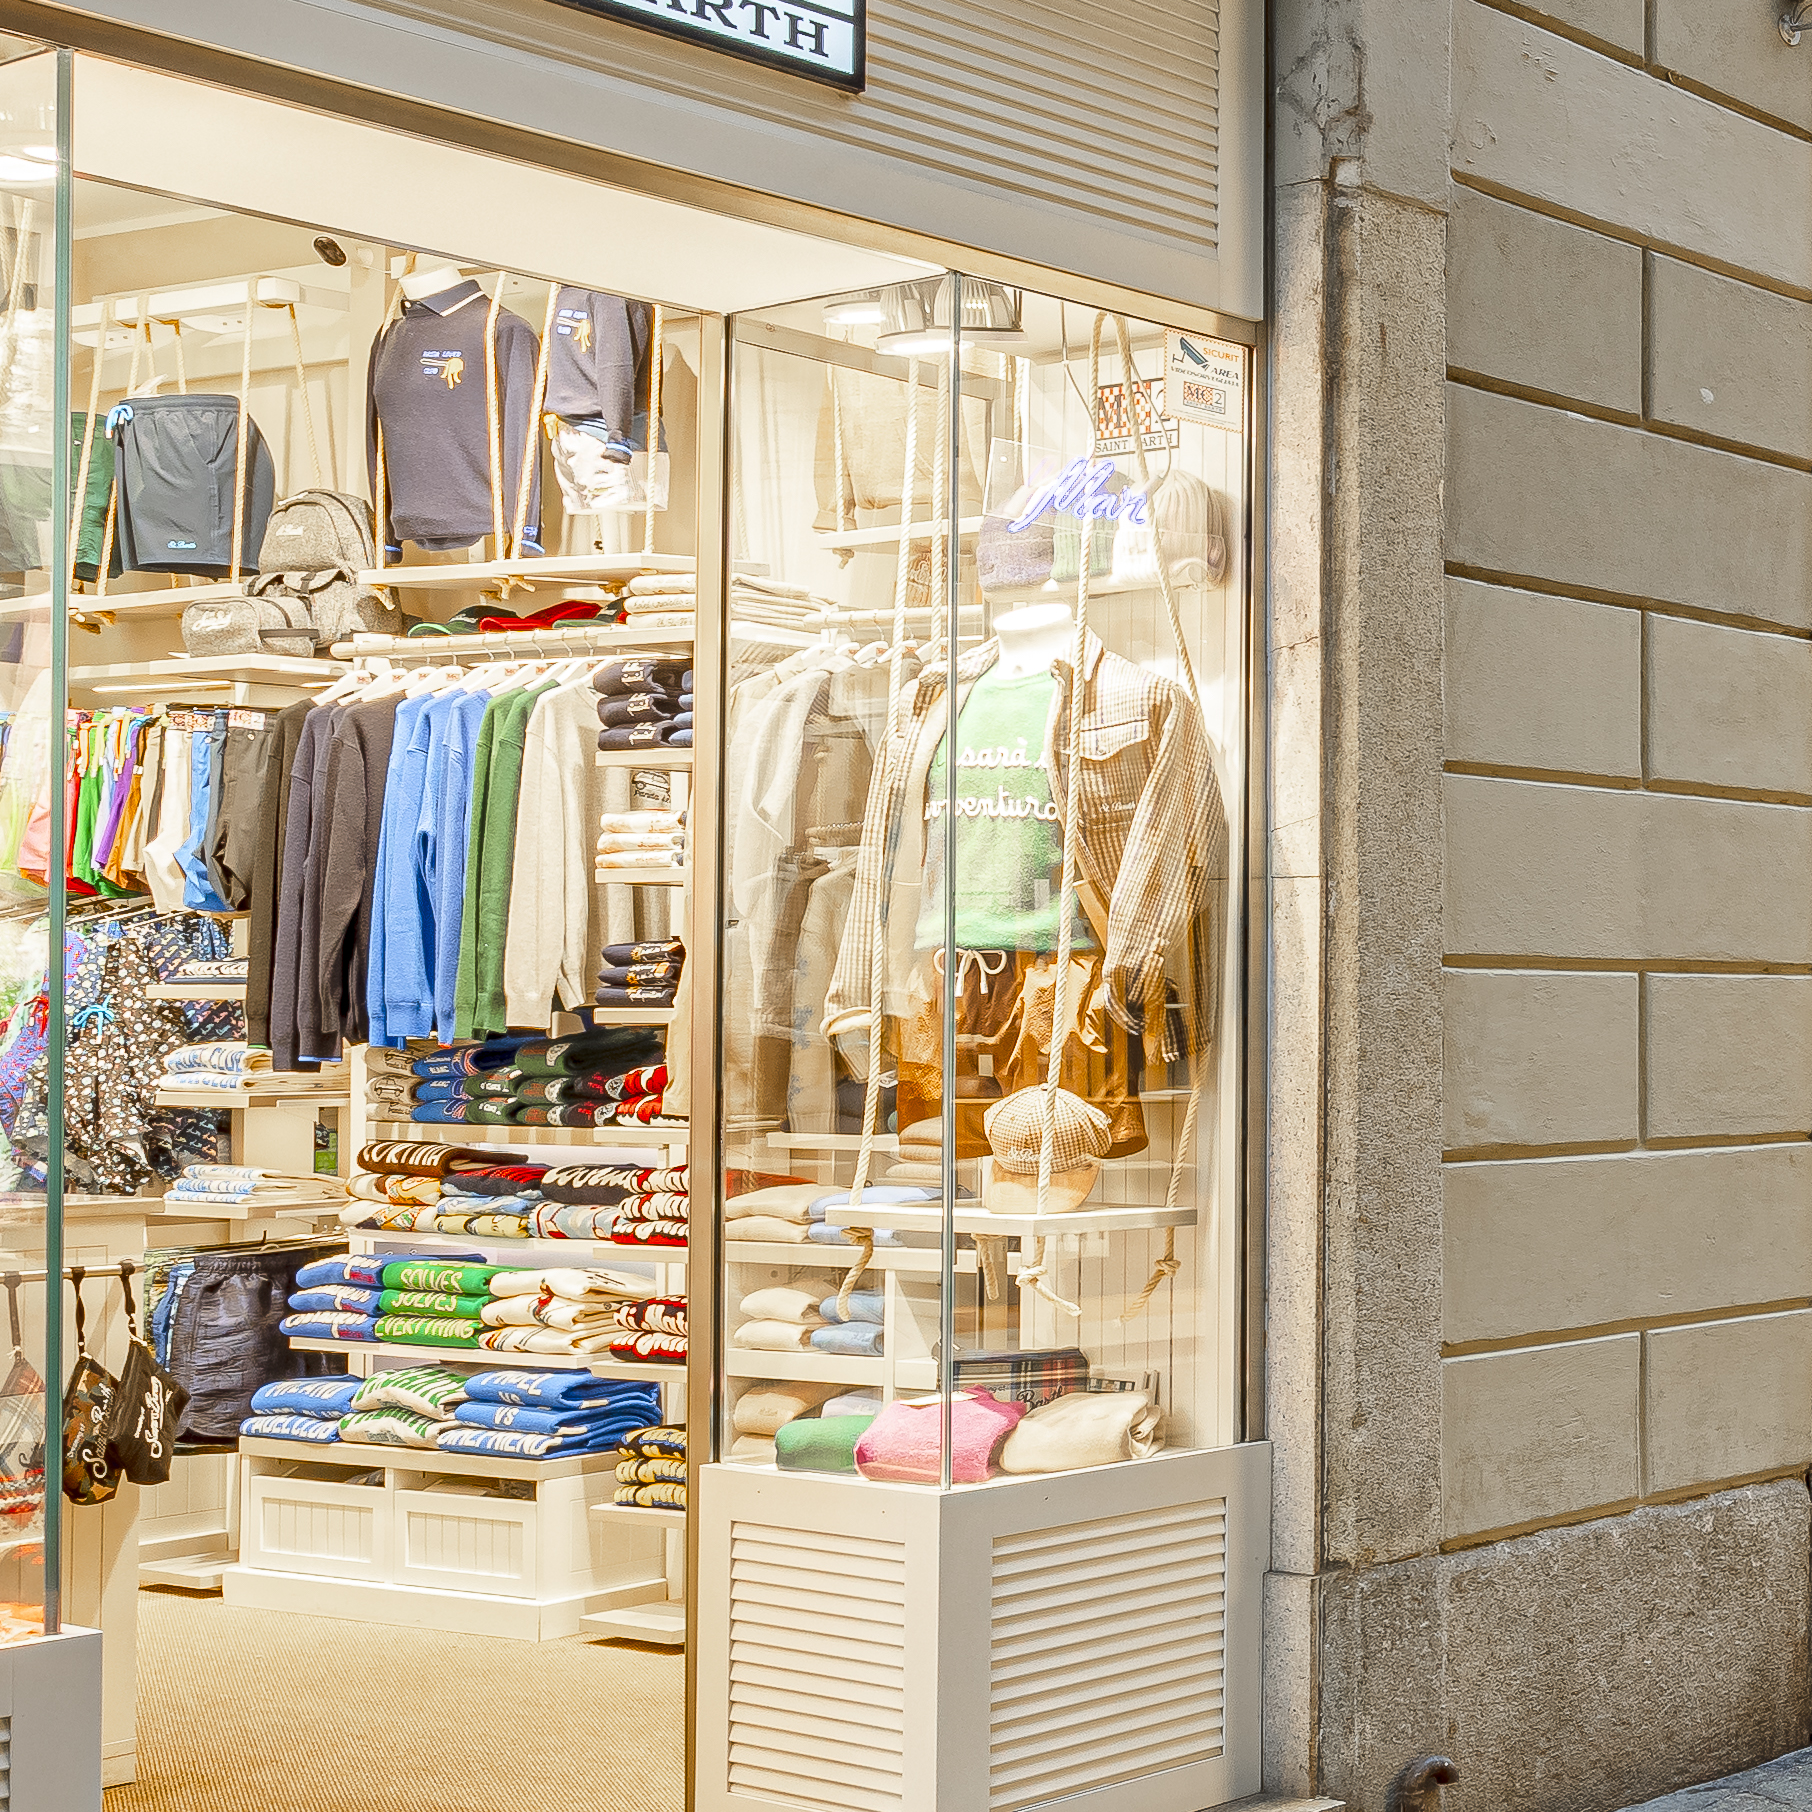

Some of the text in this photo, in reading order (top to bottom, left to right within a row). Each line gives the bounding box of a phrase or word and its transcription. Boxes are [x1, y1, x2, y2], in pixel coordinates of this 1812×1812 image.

[1203, 347, 1239, 363] SICURIT
[1210, 367, 1239, 380] AREA
[1095, 433, 1173, 453] SAINT ARTH
[955, 737, 1032, 768] sarà
[374, 1314, 476, 1339] EVERYTHING
[494, 1406, 520, 1426] VS
